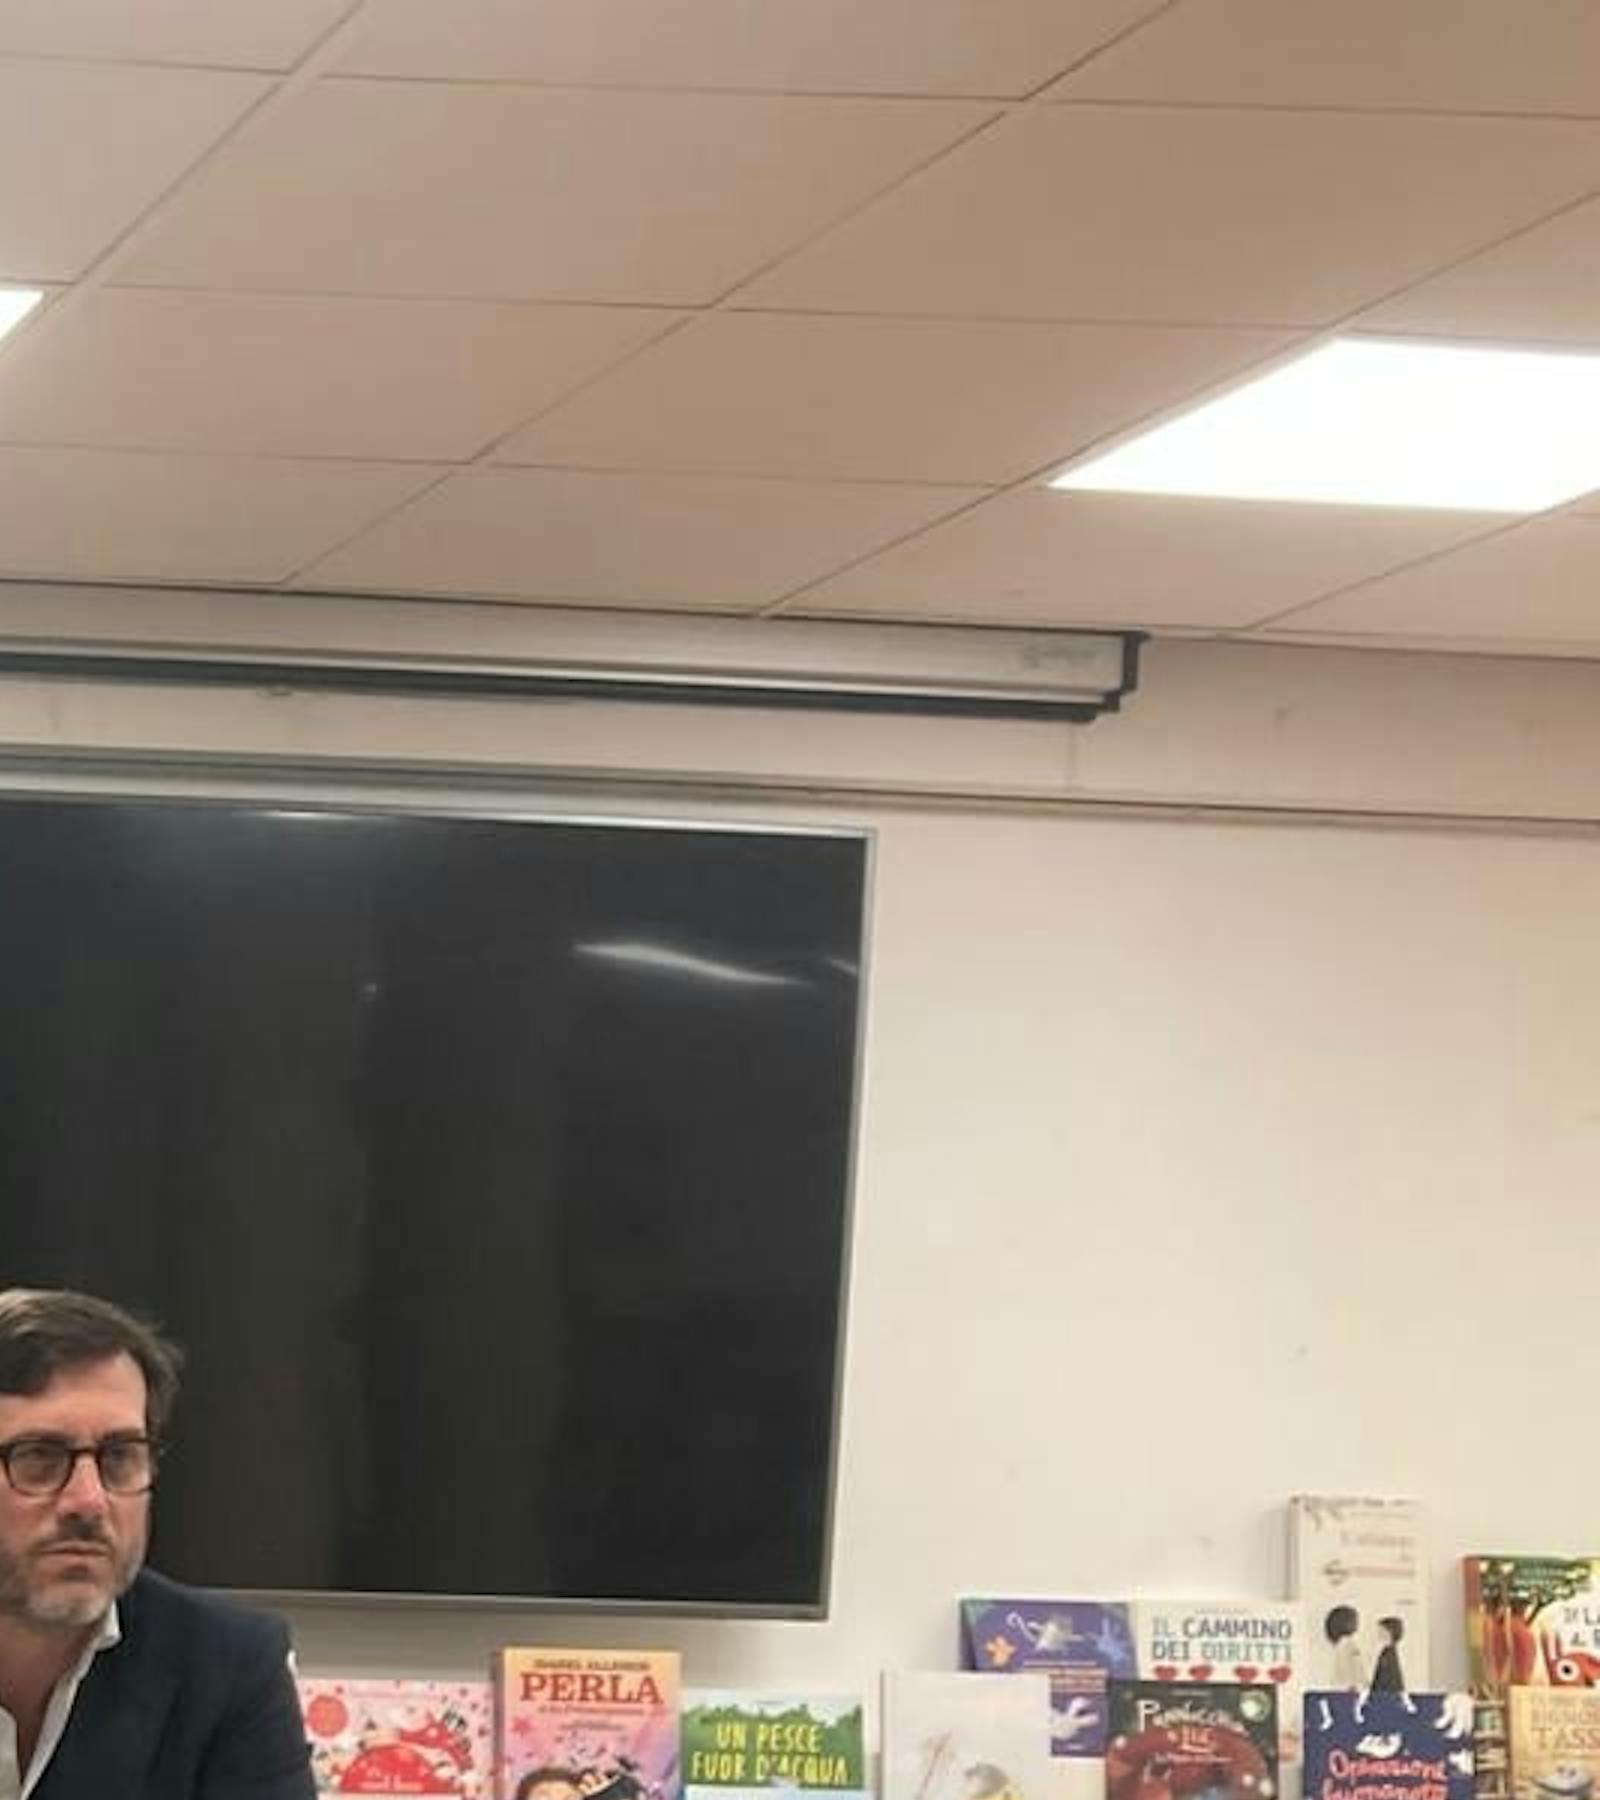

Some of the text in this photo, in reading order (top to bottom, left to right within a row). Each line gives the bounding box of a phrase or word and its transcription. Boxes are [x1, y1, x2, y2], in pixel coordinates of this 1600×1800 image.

[1153, 1617, 1292, 1639] IL CAMMINO
[1152, 1641, 1293, 1663] DEI DIRITTI
[520, 1671, 665, 1705] PERLA
[716, 1720, 823, 1753] UN PESCE
[692, 1751, 849, 1785] FUOR D'ACQUA
